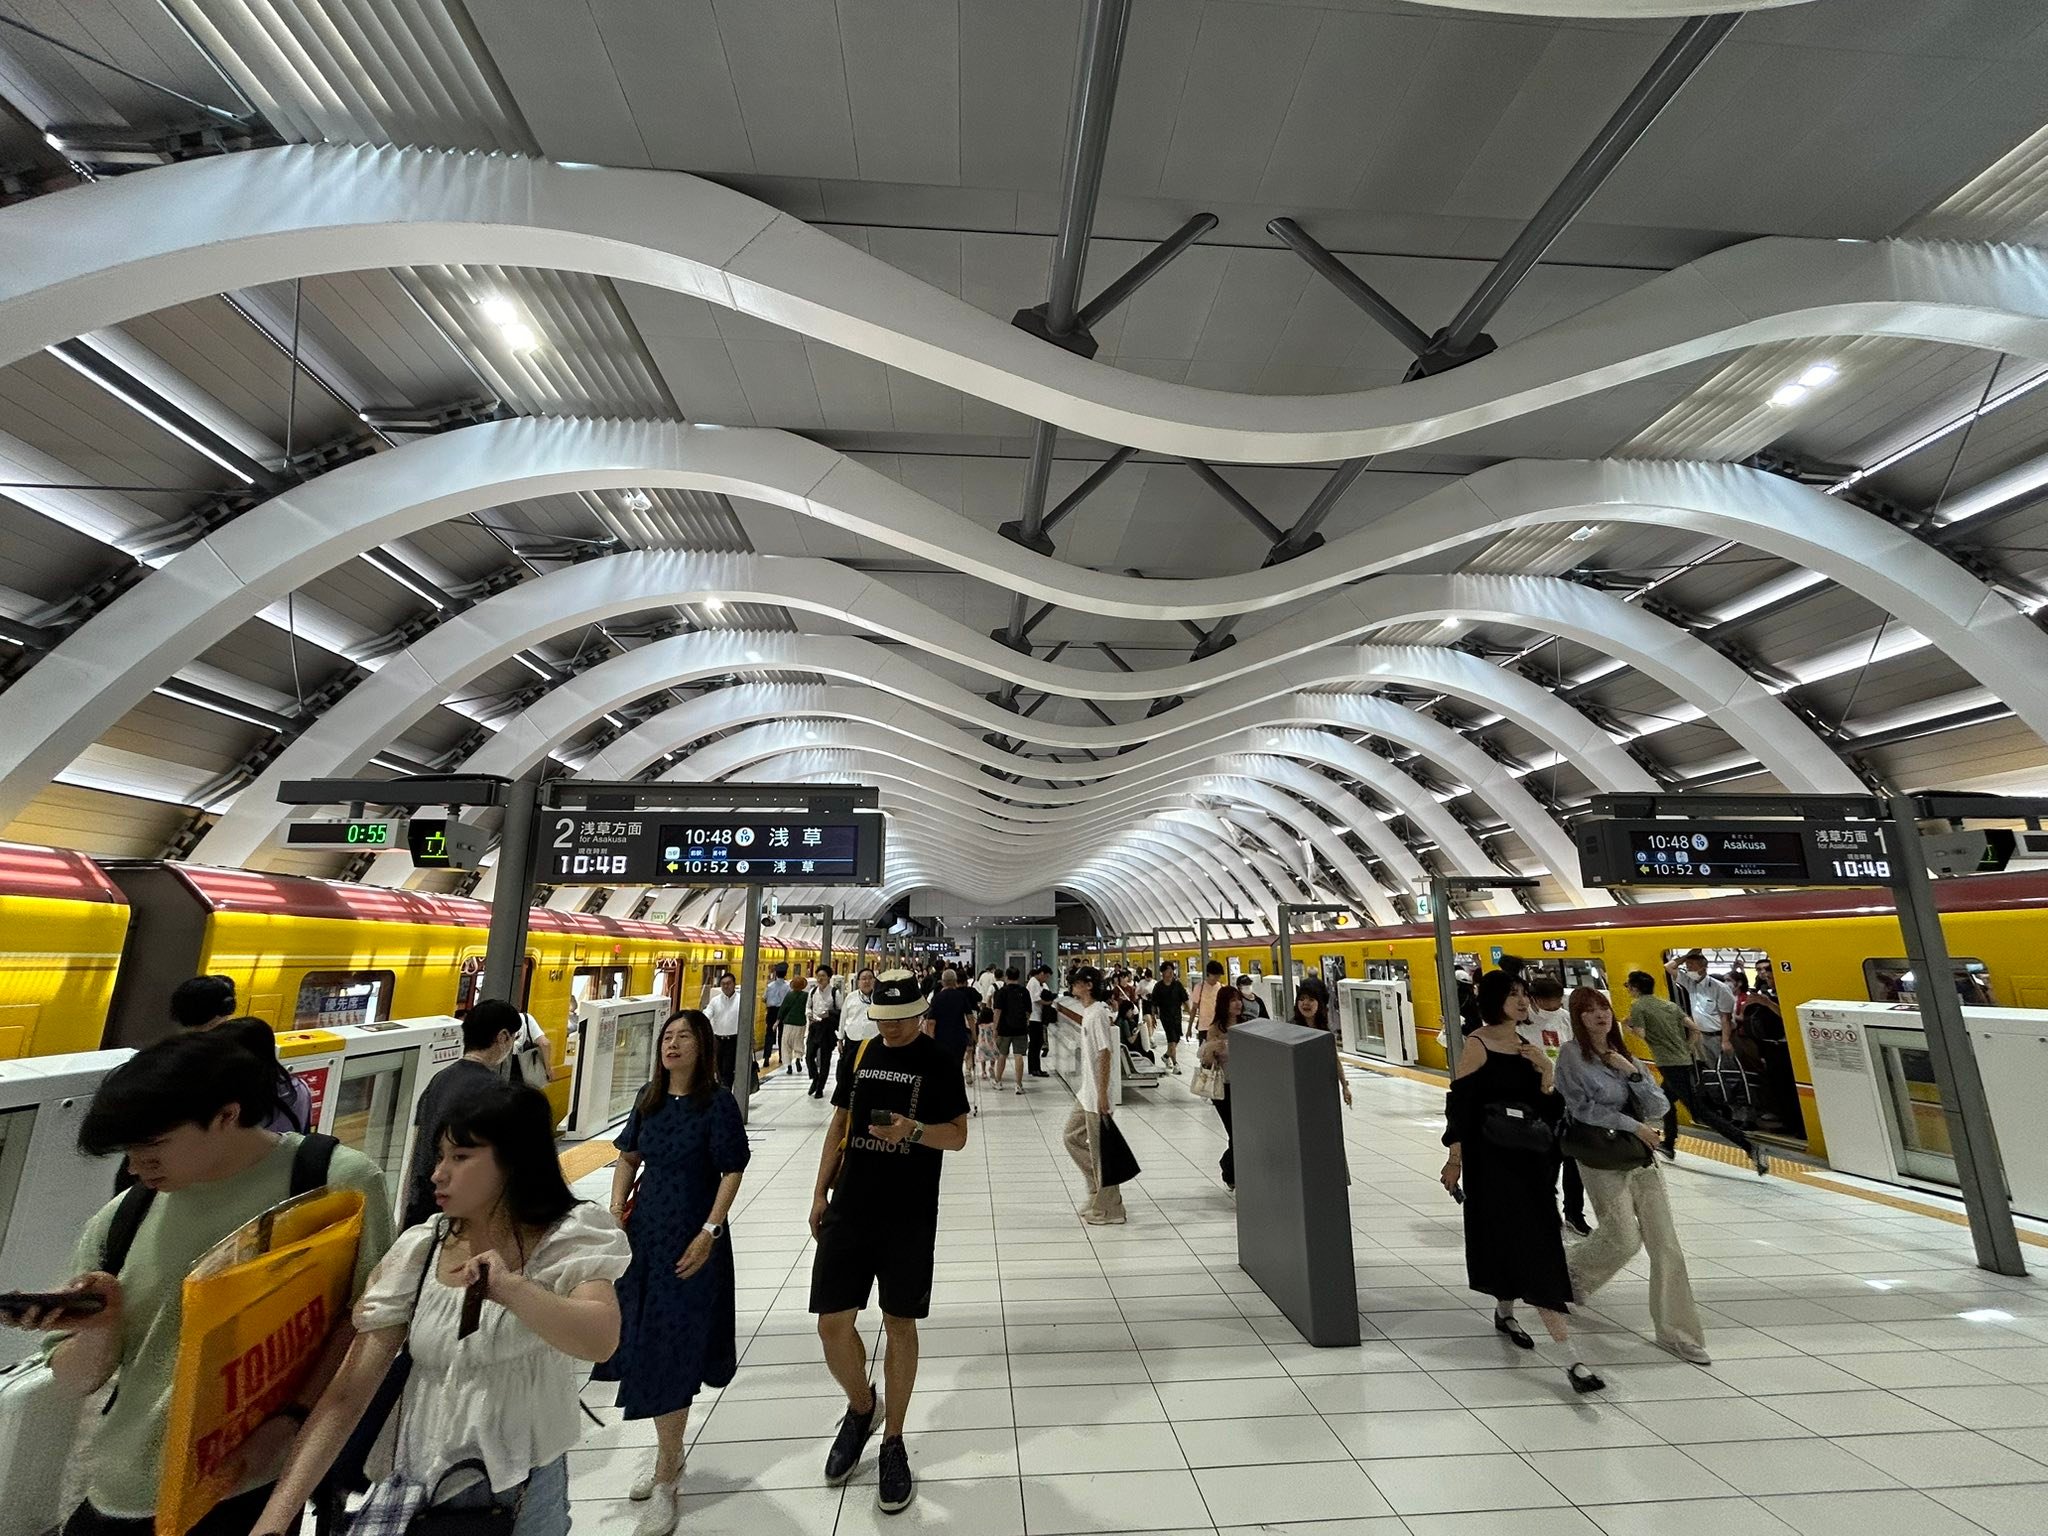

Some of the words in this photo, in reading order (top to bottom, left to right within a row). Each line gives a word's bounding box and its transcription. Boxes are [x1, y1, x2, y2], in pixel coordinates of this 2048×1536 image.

[347, 825, 388, 843] 0:55
[553, 818, 575, 848] 2
[580, 821, 643, 836] 浅草方面
[685, 829, 732, 845] 10:48
[768, 827, 823, 848] 浅草
[1648, 835, 1689, 849] 10:48
[1815, 830, 1868, 843] 浅草方面
[1873, 827, 1888, 854] 1
[1723, 840, 1767, 850] Asakusa
[560, 855, 627, 874] 10:48
[684, 862, 729, 873] 10:52
[1653, 864, 1694, 875] 10:52
[1733, 867, 1766, 875] Asakusa
[1832, 861, 1891, 878] 10:48
[859, 1069, 917, 1084] BURBERRY
